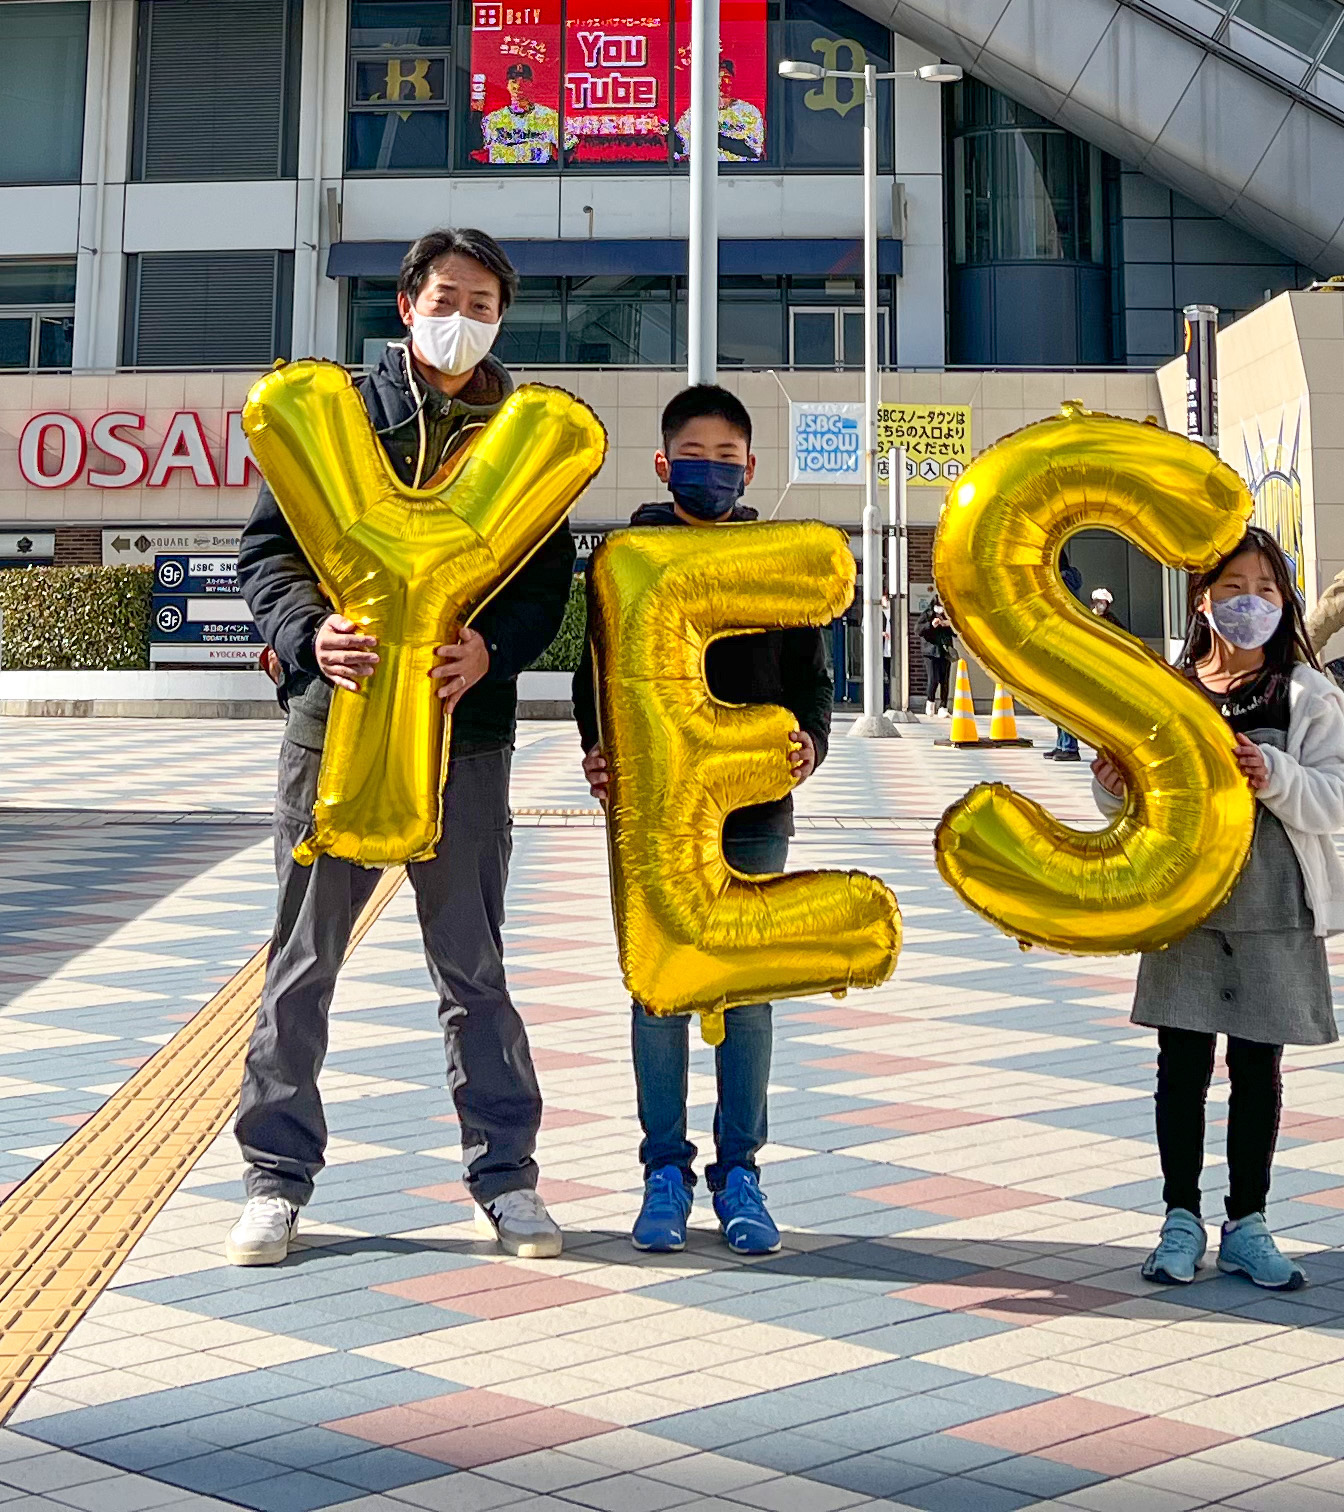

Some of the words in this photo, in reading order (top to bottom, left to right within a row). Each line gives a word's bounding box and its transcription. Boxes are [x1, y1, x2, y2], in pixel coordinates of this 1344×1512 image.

[797, 414, 842, 433] JSBC
[796, 433, 859, 452] SNOW
[796, 451, 859, 472] TOWN
[151, 538, 189, 547] SQUARE
[163, 566, 180, 582] 9F
[190, 563, 214, 572] JSBC
[161, 611, 179, 627] 3F
